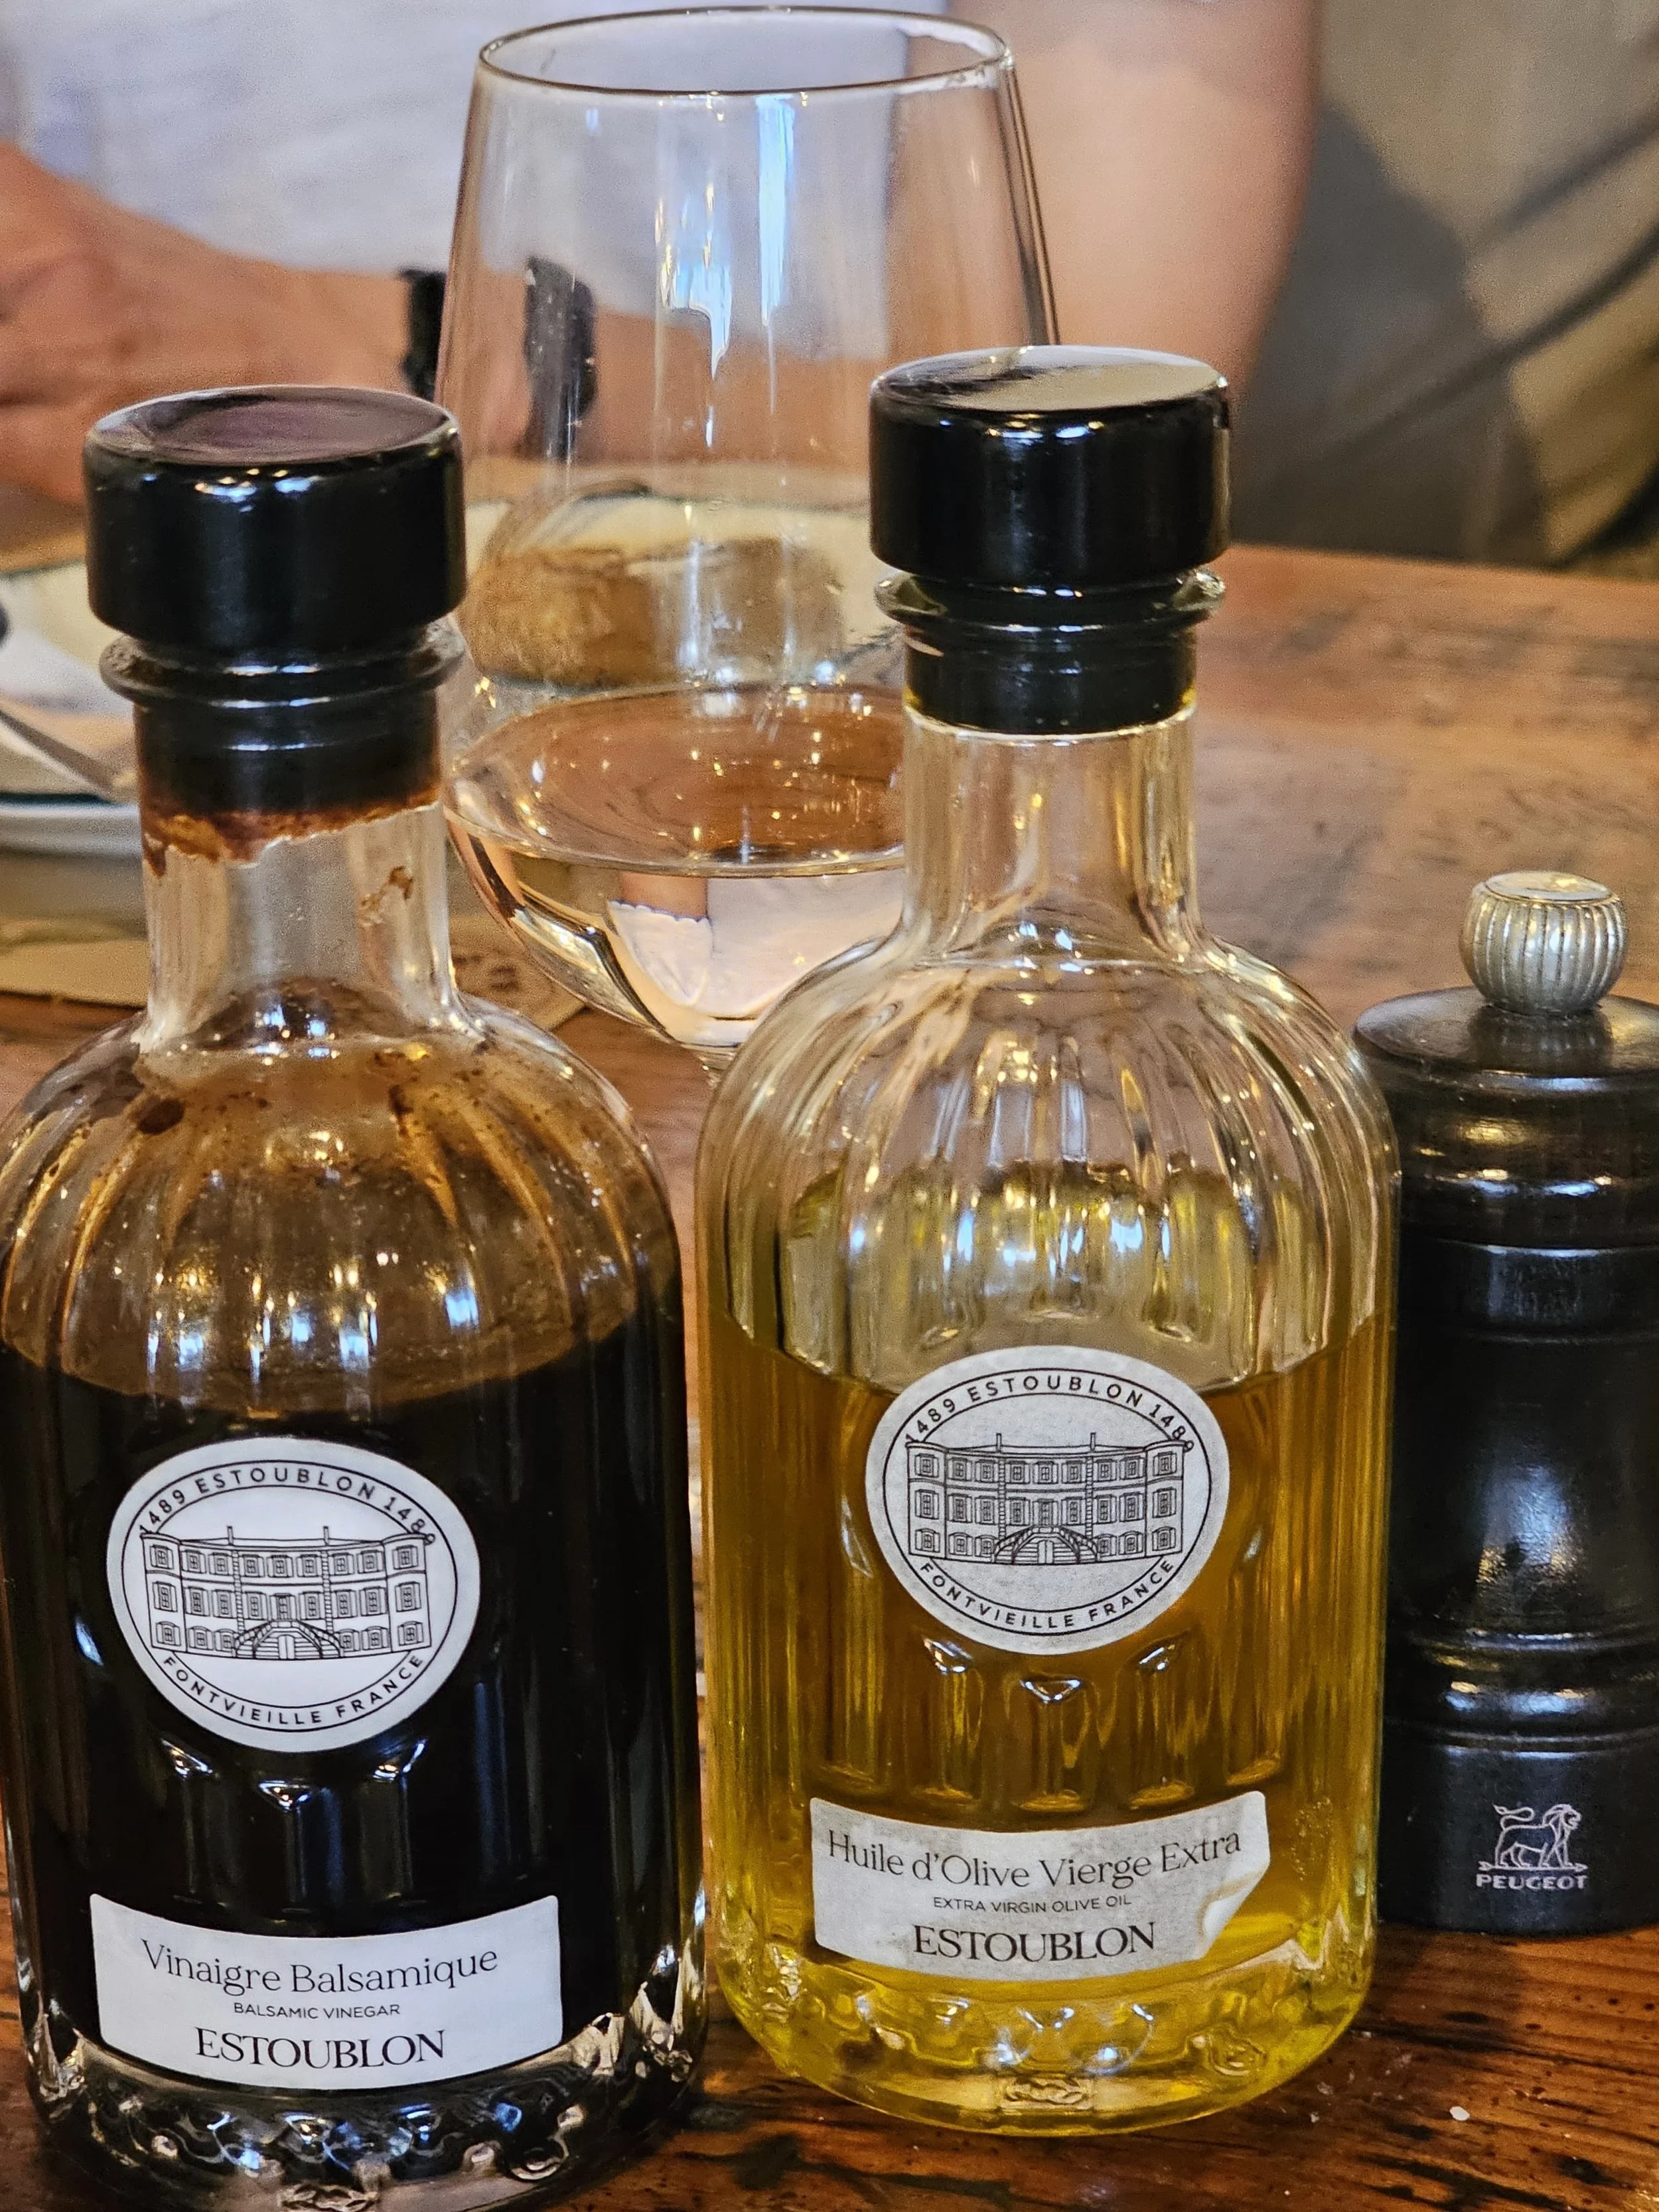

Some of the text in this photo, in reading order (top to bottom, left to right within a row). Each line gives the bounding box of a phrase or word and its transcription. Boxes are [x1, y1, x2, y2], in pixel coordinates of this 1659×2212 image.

[968, 1374, 1143, 1408] ESTOUBLON
[198, 1467, 376, 1501] ESTOUBLON
[920, 1560, 1174, 1629] FONTVIEILLE FRANCE
[164, 1655, 423, 1725] FONTVIEILLE FRANCE
[828, 1829, 904, 1876] Huile
[1039, 1854, 1152, 1889] Vierge
[1160, 1832, 1241, 1872] Extra
[1475, 1873, 1589, 1890] PEUGEOT
[933, 1895, 1132, 1913] EXTRA VIRGIN OLIVE OIL
[912, 1921, 1157, 1962] ESTOUBLON
[141, 1938, 499, 1996] Vinaigre Balsamique
[234, 2002, 401, 2020] BALSAMIC VINEGAR
[195, 2026, 446, 2069] ESTOUBLON
